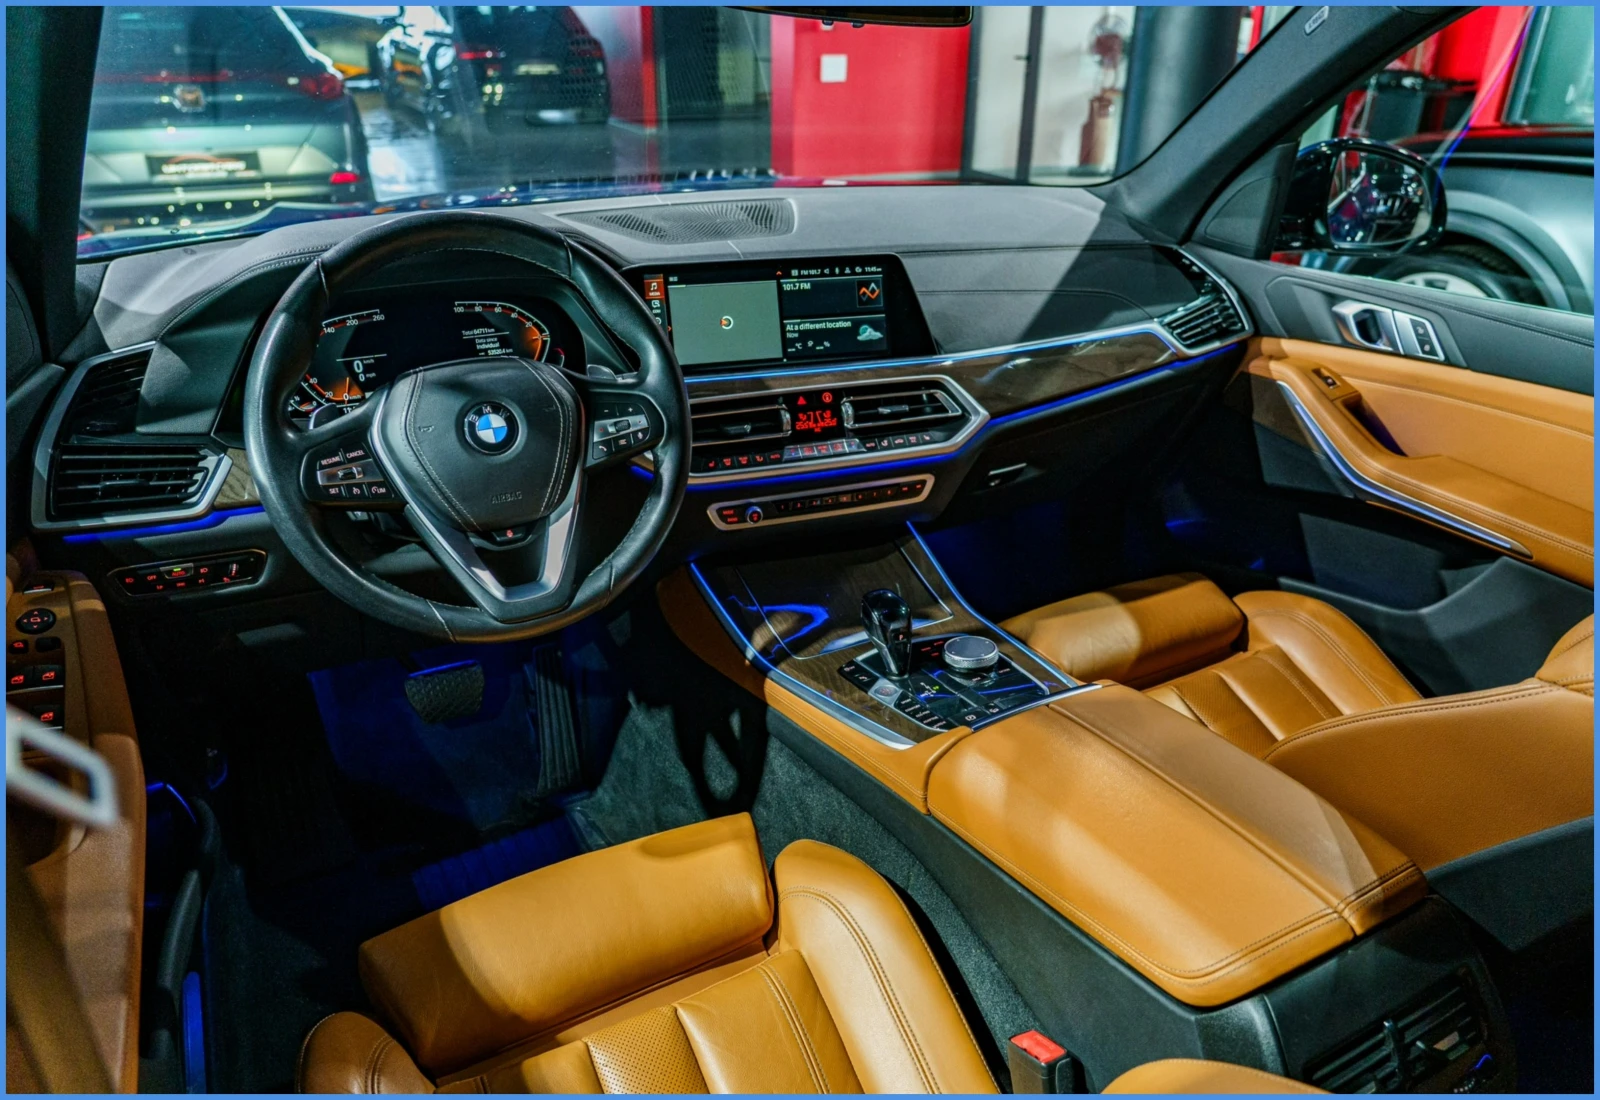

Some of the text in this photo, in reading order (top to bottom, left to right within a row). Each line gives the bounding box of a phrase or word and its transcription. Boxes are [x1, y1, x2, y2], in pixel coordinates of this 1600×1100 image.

[353, 360, 363, 373] 0
[469, 404, 509, 423] BMW
[321, 456, 340, 465] RESUME
[346, 450, 365, 458] CANCEL
[491, 491, 522, 504] AIRBAG
